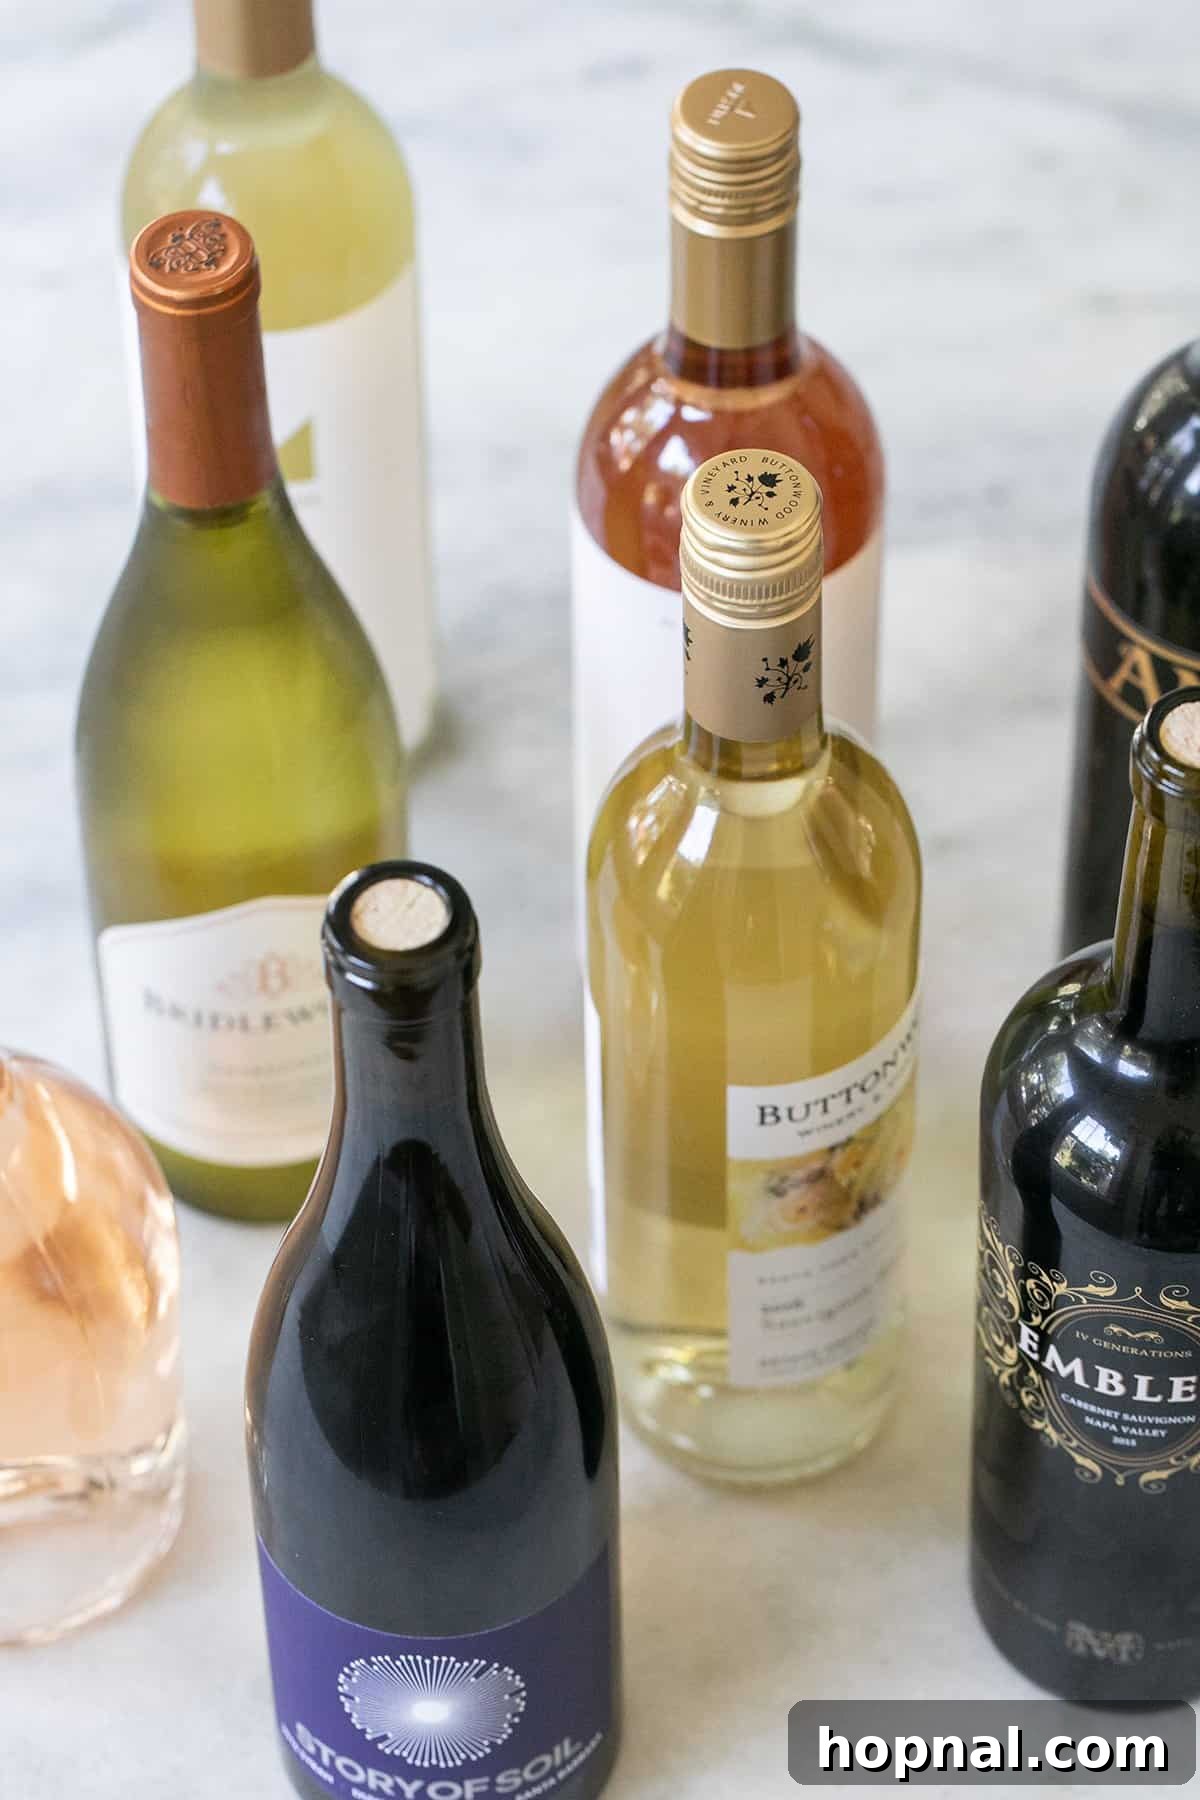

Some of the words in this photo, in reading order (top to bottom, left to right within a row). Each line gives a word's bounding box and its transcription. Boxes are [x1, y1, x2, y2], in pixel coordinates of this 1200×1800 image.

[700, 455, 748, 495] VINEYARD
[761, 456, 803, 520] BUTTONWOOD
[714, 510, 769, 527] WINERY
[1101, 642, 1200, 707] A
[1075, 1330, 1089, 1341] IV
[1092, 1337, 1193, 1359] GENERATIONS
[1060, 1392, 1120, 1420] CABERNET
[1121, 1412, 1197, 1426] SAUVIGNON
[1084, 1415, 1119, 1433] NAPA
[1121, 1425, 1169, 1438] VALLEY
[295, 1721, 424, 1800] STORY
[426, 1776, 491, 1800] OF
[495, 1737, 583, 1794] SOIL
